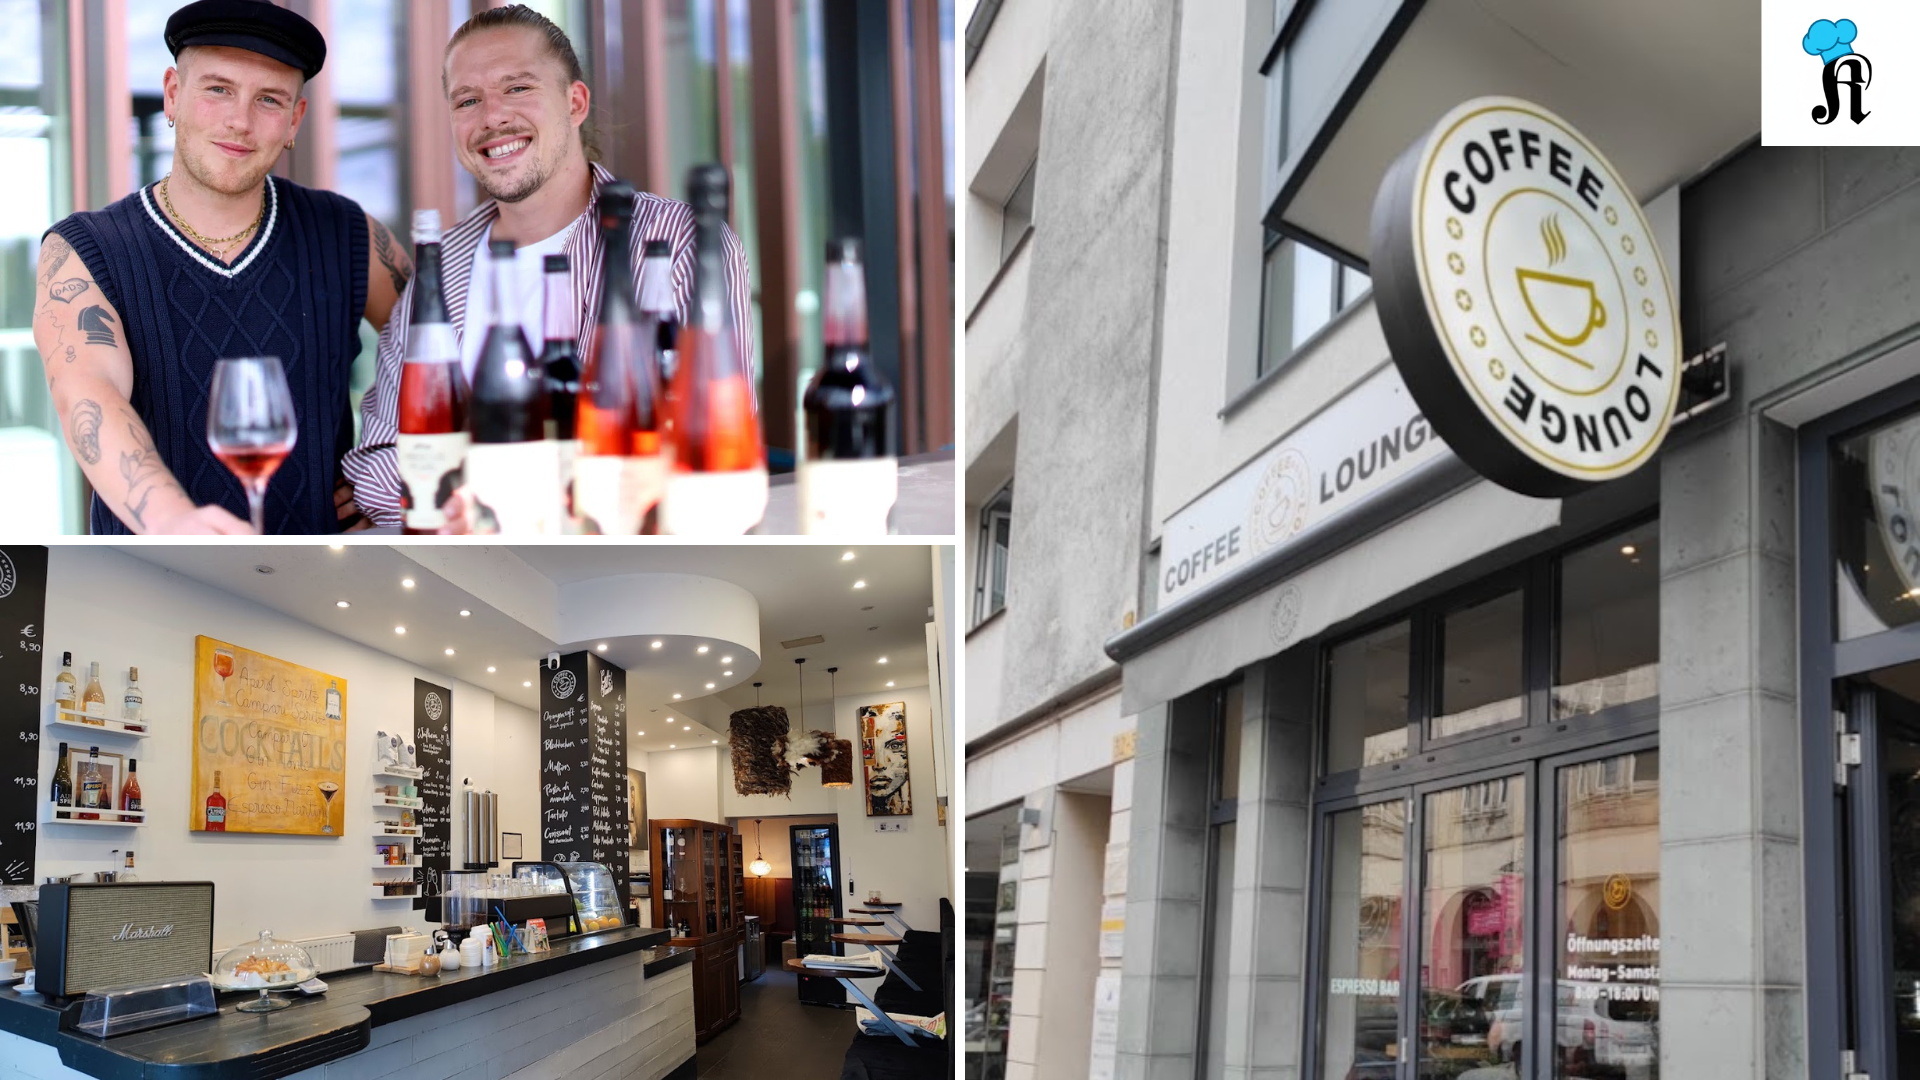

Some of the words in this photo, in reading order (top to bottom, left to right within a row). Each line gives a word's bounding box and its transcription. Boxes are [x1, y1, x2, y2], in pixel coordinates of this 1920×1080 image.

[1443, 128, 1604, 215] COFFEE
[55, 282, 84, 297] DADS
[1503, 352, 1664, 453] LOUNGE
[1164, 525, 1241, 594] COFFEE
[20, 640, 41, 652] 8,90
[19, 683, 39, 695] 8,90
[19, 731, 39, 742] 8,90
[200, 715, 343, 772] COCKTAILS
[13, 776, 36, 788] 11,90
[14, 821, 35, 833] 11,90
[112, 923, 174, 942] Marshall
[1567, 933, 1660, 955] Öffnungszeite
[1331, 978, 1378, 996] ESPRESSO
[1643, 986, 1660, 1000] Uh
